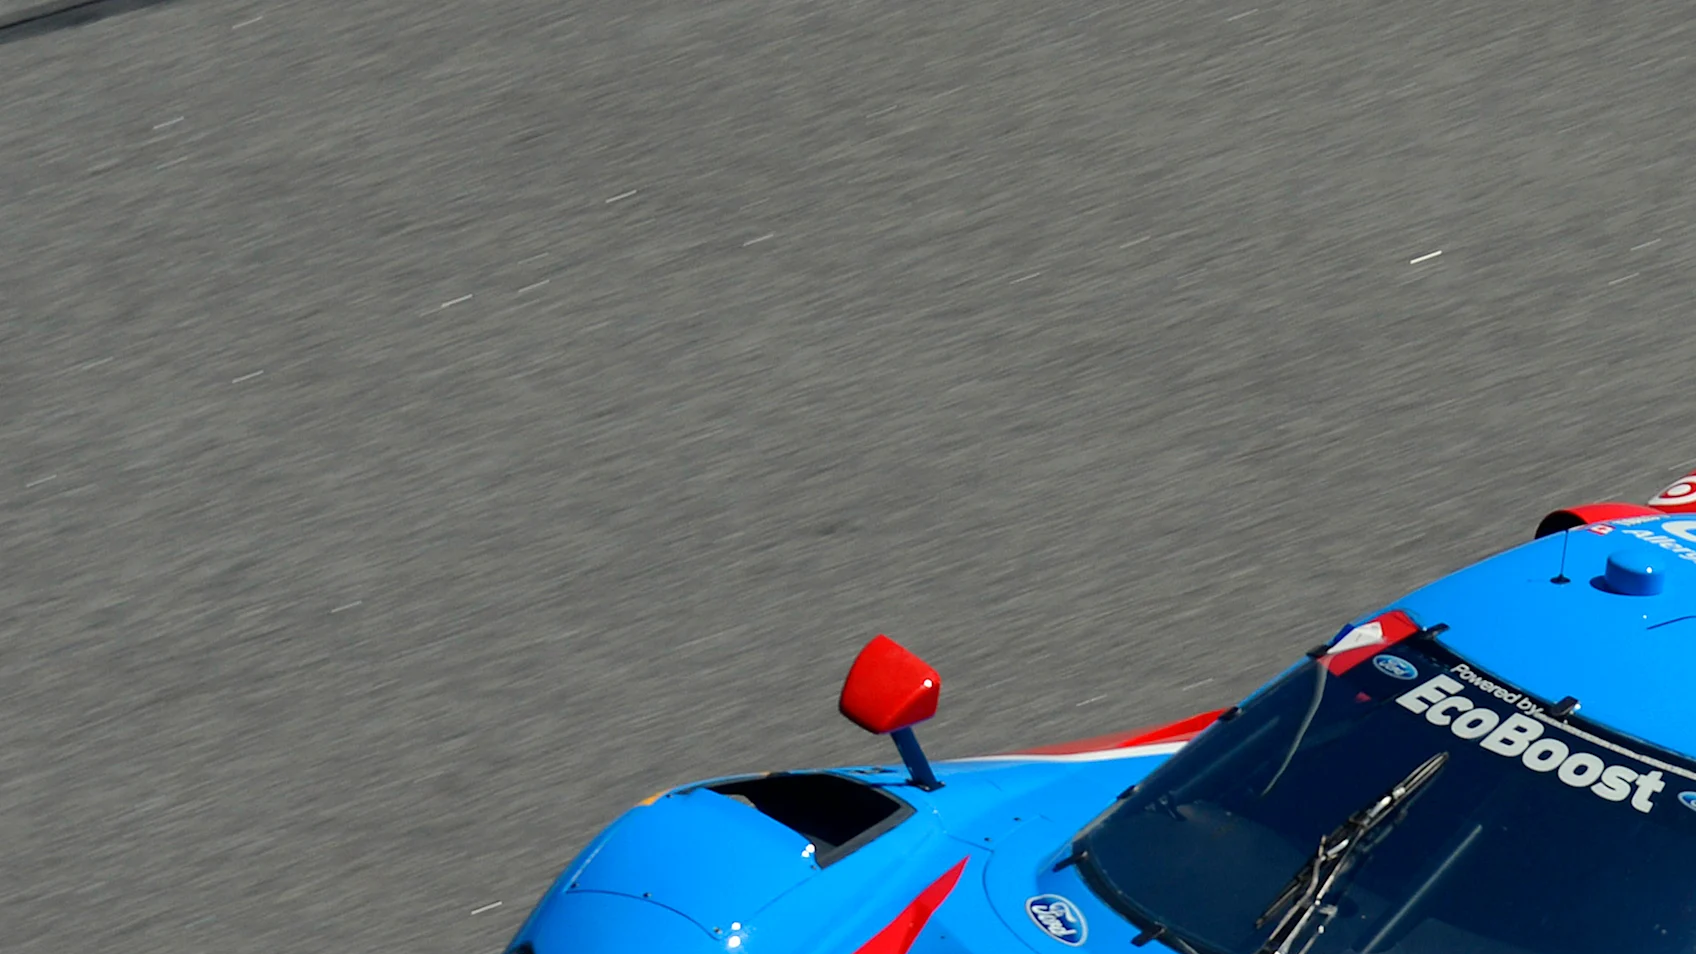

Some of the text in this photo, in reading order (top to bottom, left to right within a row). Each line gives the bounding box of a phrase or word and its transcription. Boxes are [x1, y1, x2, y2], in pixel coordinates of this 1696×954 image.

[1450, 663, 1544, 716] Powered by
[1396, 674, 1665, 813] EcoBoost
[1032, 902, 1077, 936] Ford
